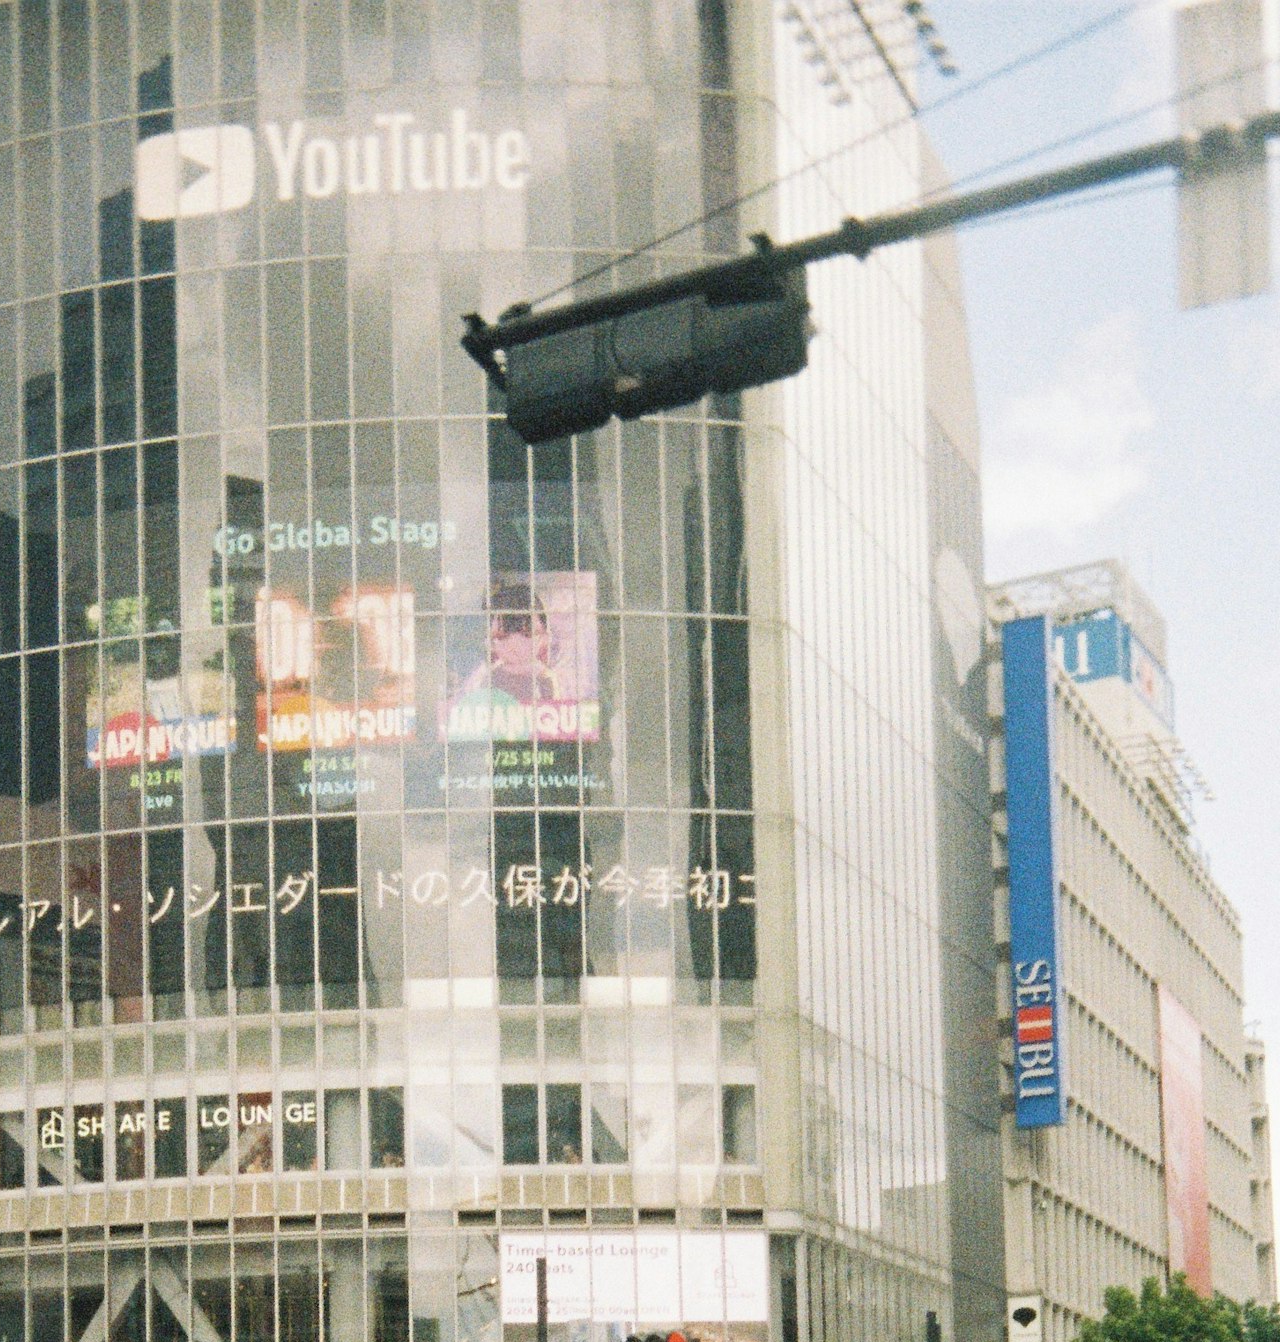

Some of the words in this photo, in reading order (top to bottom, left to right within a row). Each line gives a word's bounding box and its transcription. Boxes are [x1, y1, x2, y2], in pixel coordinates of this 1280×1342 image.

[265, 108, 530, 201] YouTube
[212, 524, 256, 557] Go
[129, 770, 162, 788] 823
[303, 758, 337, 773] 824
[1014, 959, 1055, 1098] SEIBU
[77, 1113, 170, 1135] SHARE
[200, 1102, 317, 1127] LOUNGE
